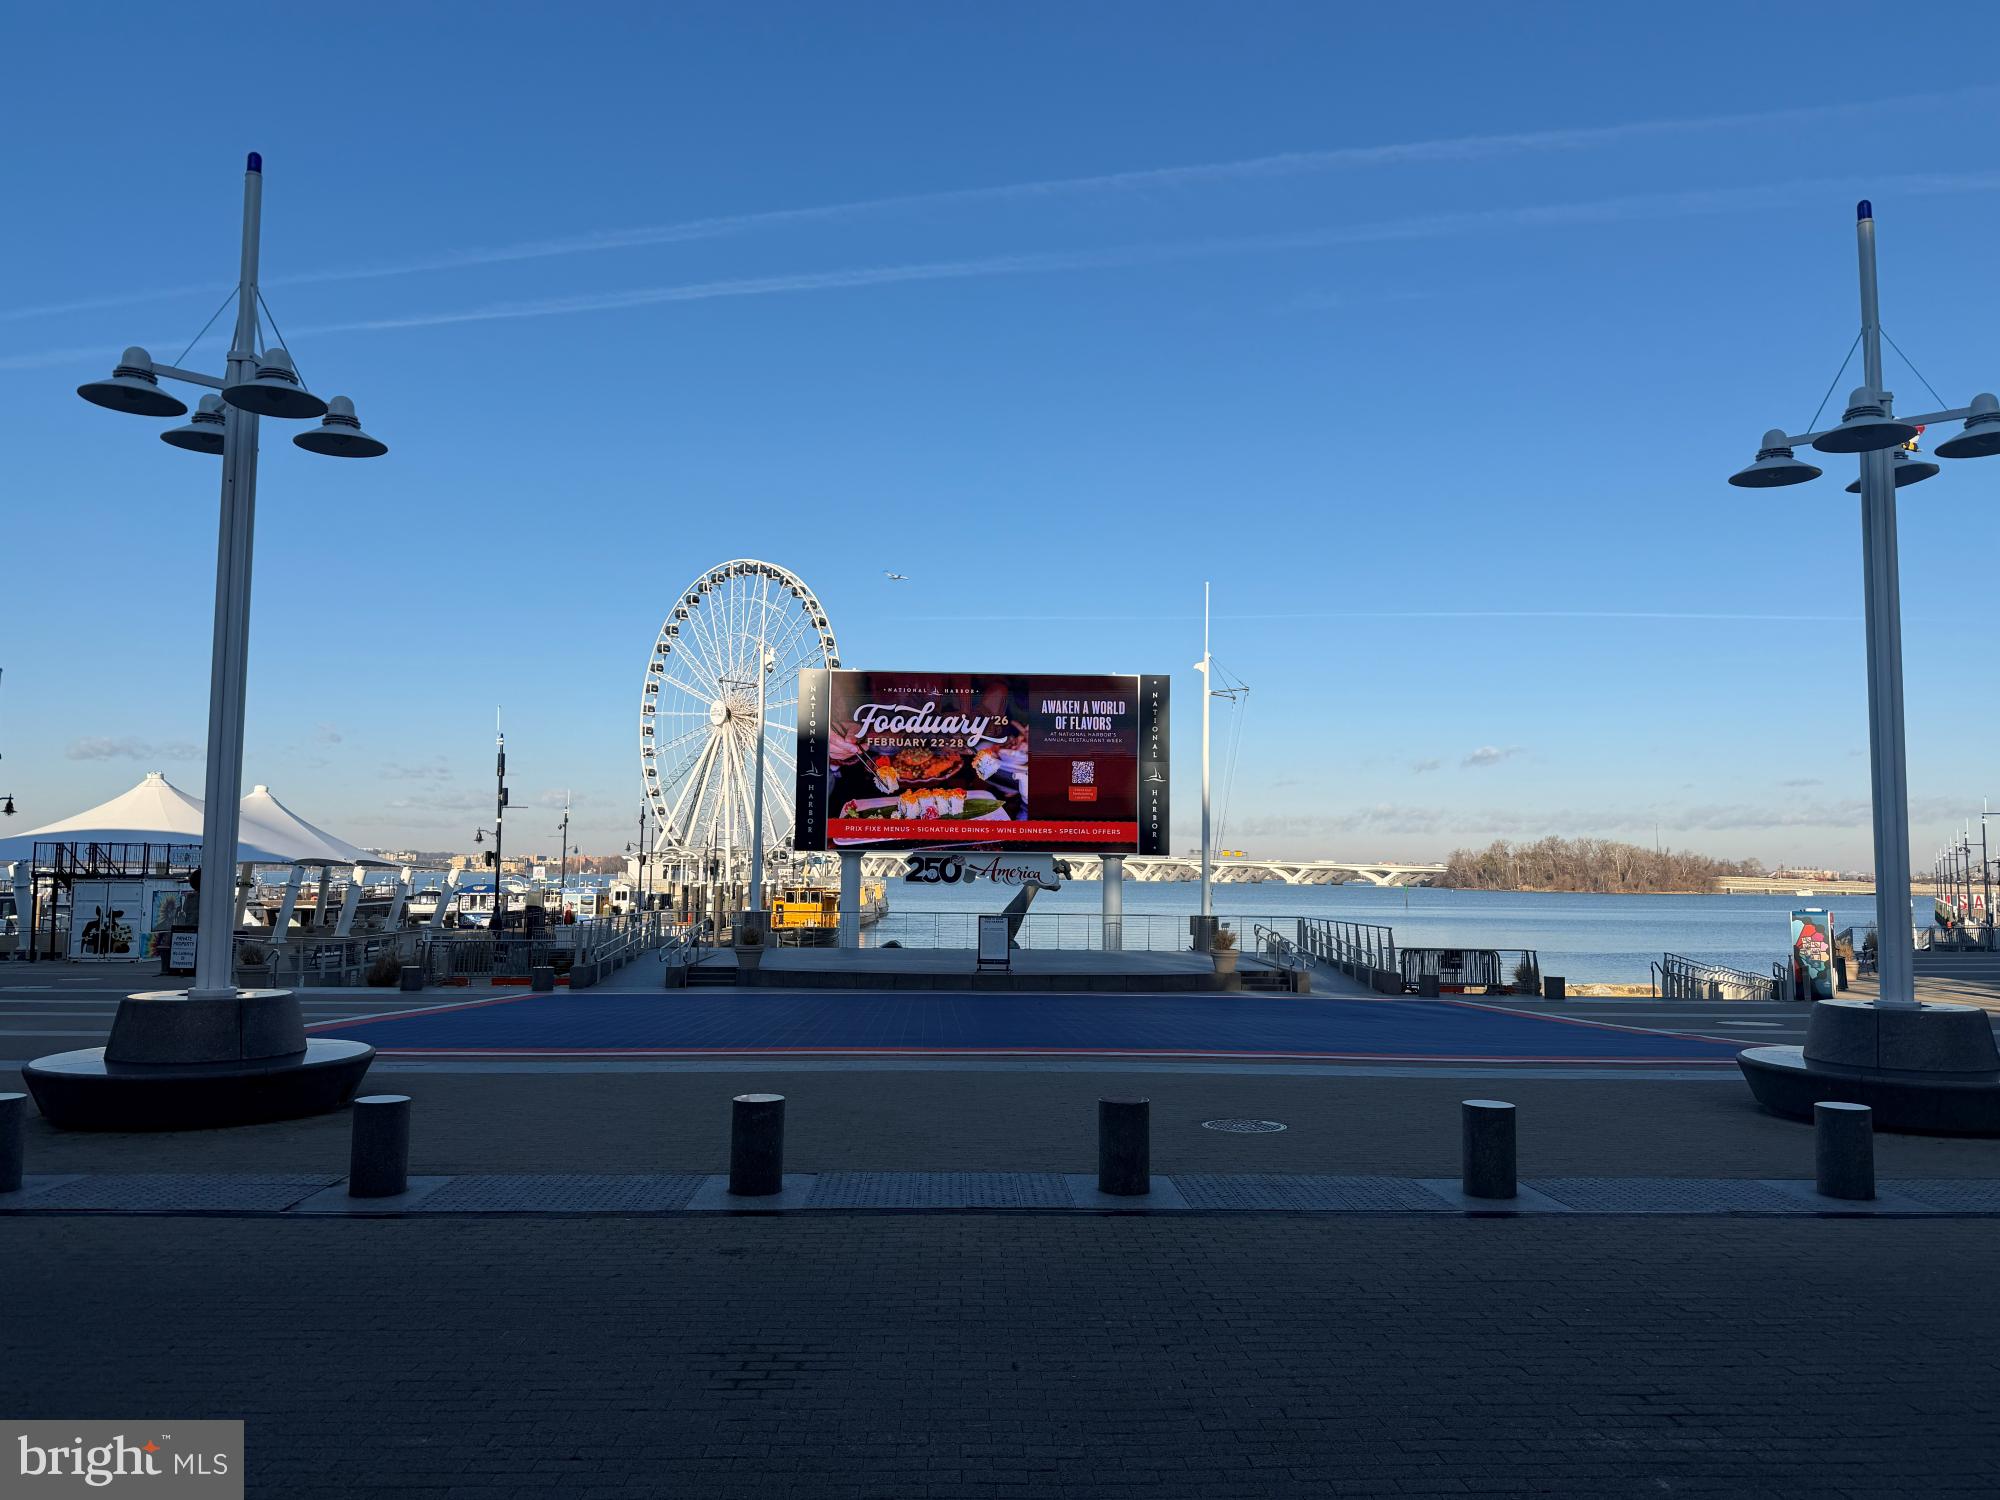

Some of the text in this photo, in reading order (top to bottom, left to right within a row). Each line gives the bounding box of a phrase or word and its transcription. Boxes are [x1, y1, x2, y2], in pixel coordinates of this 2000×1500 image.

[1041, 700, 1126, 715] AWAKEN A WORLD
[853, 701, 1008, 748] Fooduary
[1055, 715, 1112, 730] OF FLAVORS
[1151, 691, 1159, 758] NATIONAL
[866, 738, 965, 748] FEBRUARY 22-28
[807, 686, 817, 833] NATIONAL HARBOR
[905, 856, 1044, 885] 250 America
